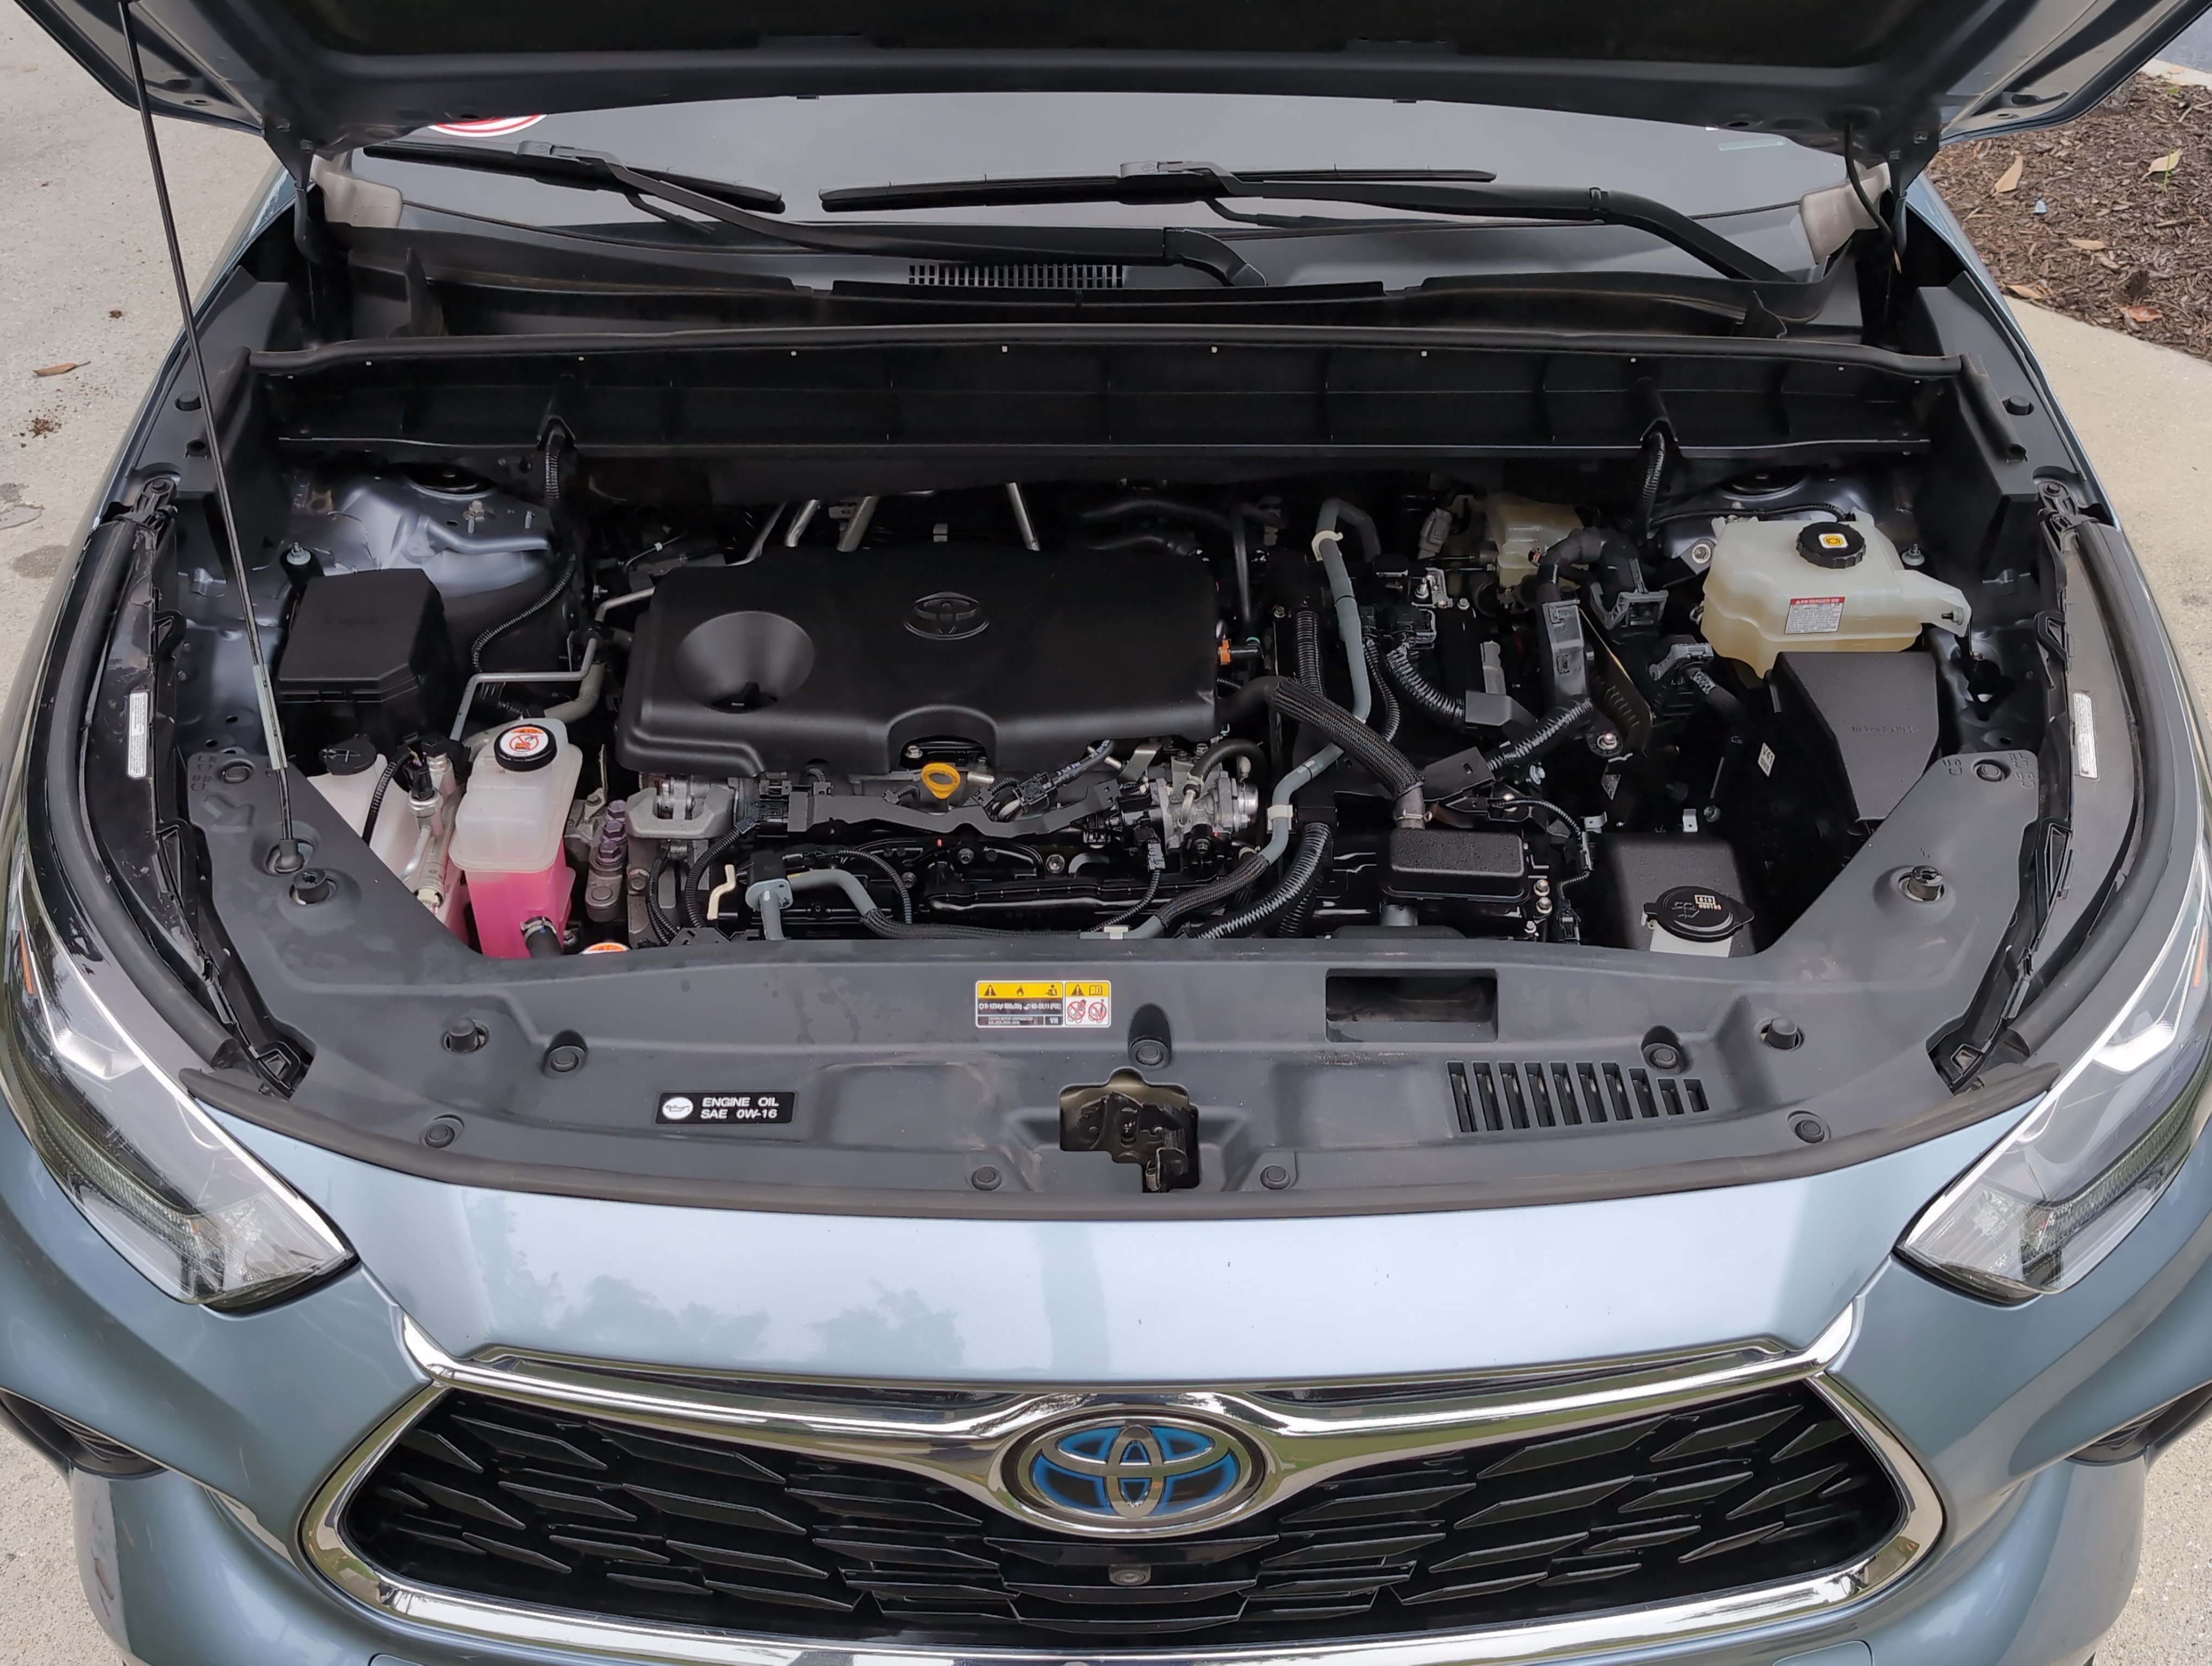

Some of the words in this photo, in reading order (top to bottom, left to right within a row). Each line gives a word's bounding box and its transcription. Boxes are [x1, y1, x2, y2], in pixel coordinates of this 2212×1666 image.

[702, 1097, 751, 1107] ENGINE
[758, 1097, 779, 1107] OIL
[700, 1108, 728, 1119] SAE
[736, 1108, 777, 1119] 0W-16
